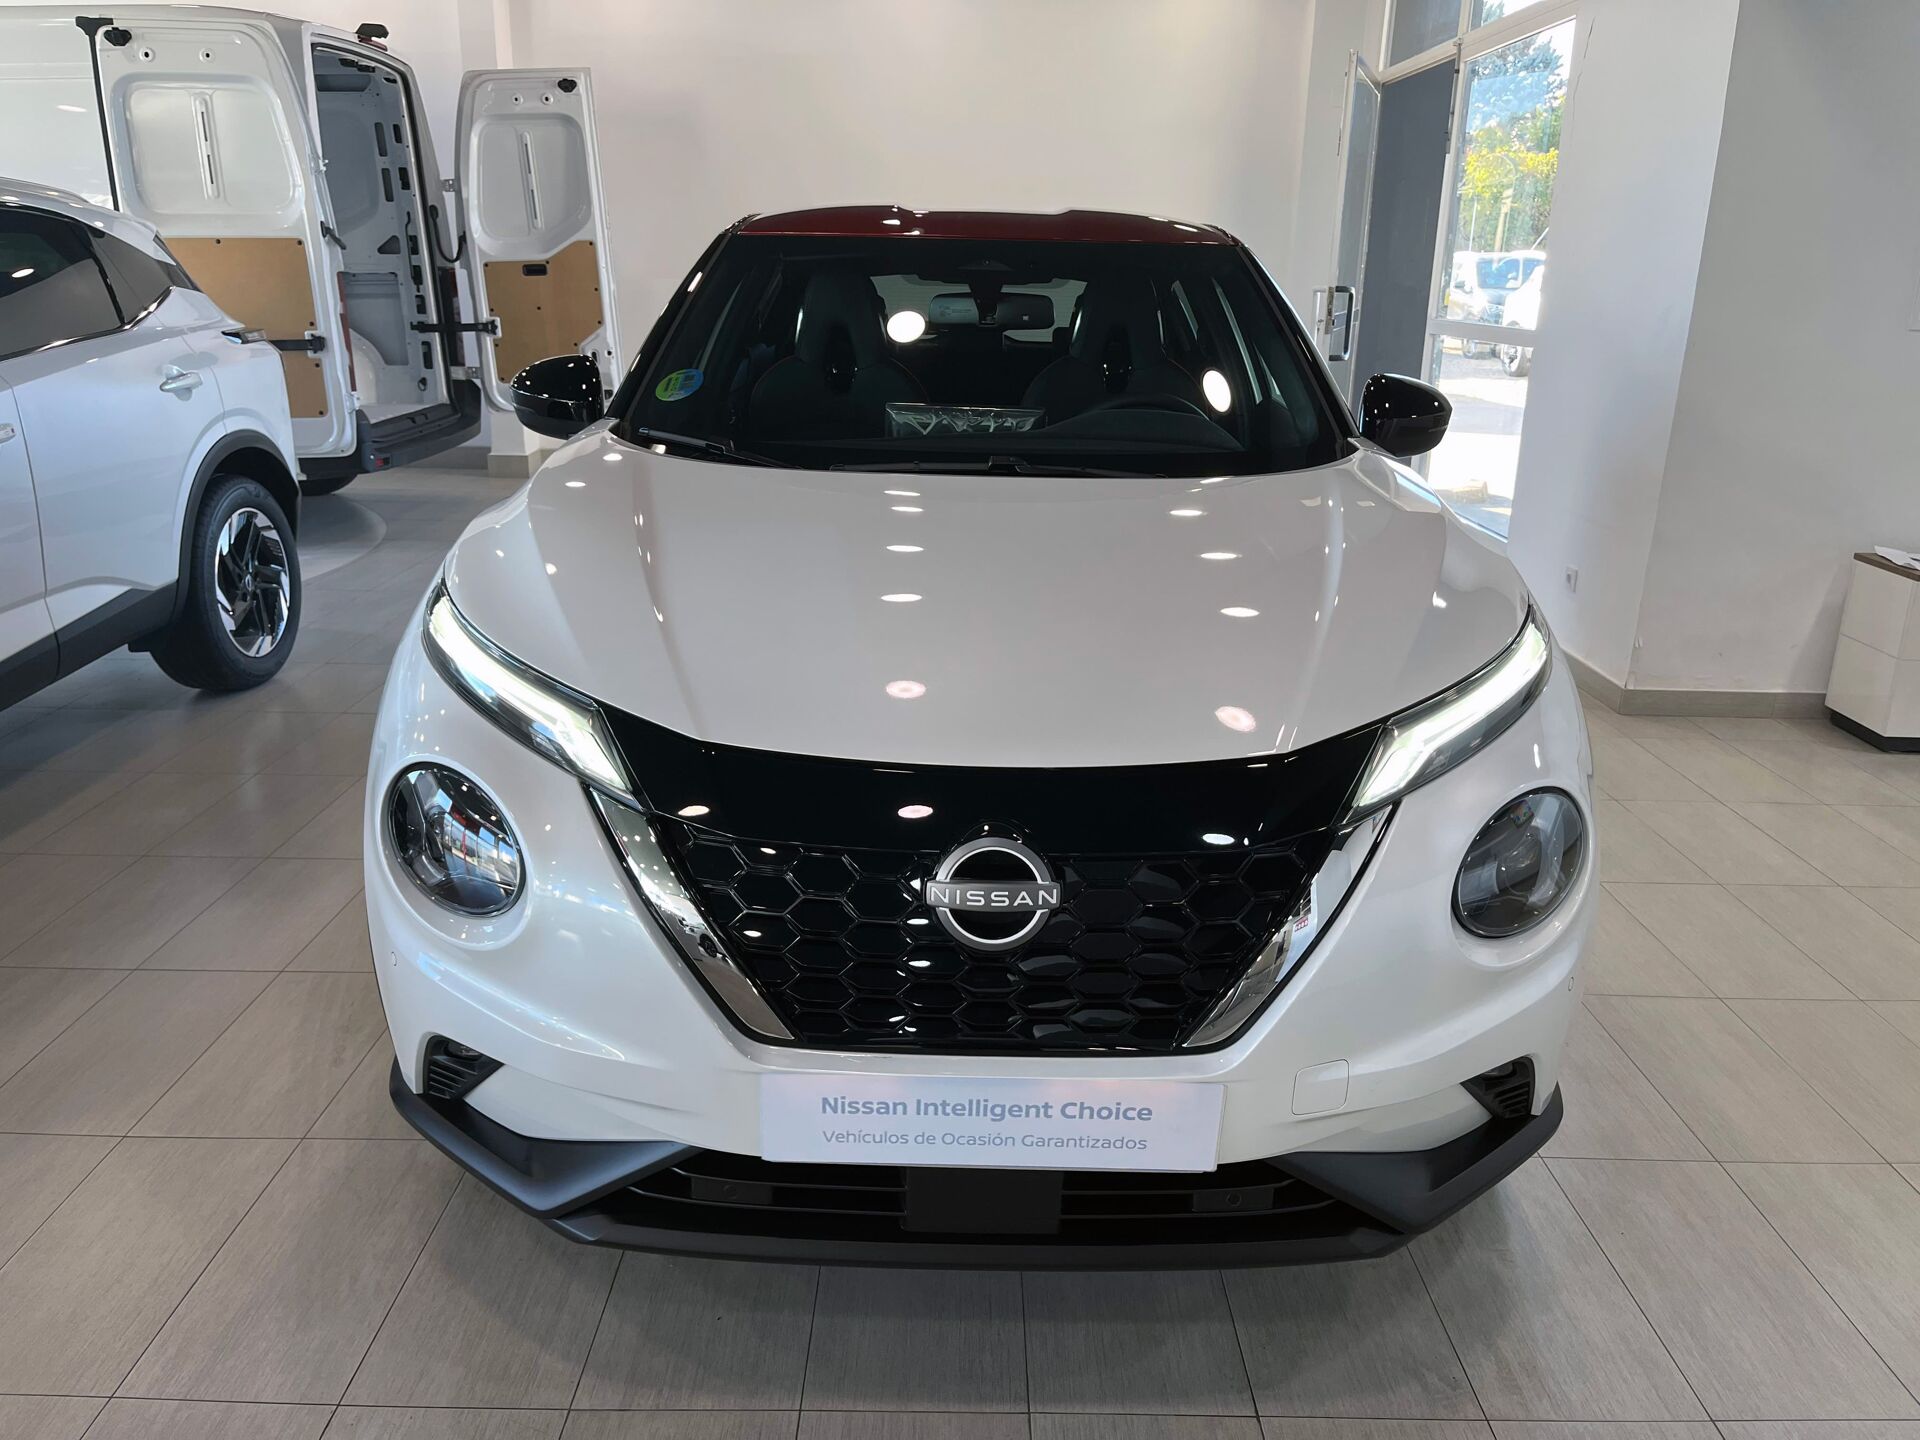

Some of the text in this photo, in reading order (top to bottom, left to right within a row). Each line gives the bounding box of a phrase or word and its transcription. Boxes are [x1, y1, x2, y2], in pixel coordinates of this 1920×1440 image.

[930, 886, 1058, 907] NISSAN
[821, 1096, 1153, 1122] Nissan Intelligent Choice
[822, 1129, 1149, 1150] Vehículos de Ocasión Garantizados
